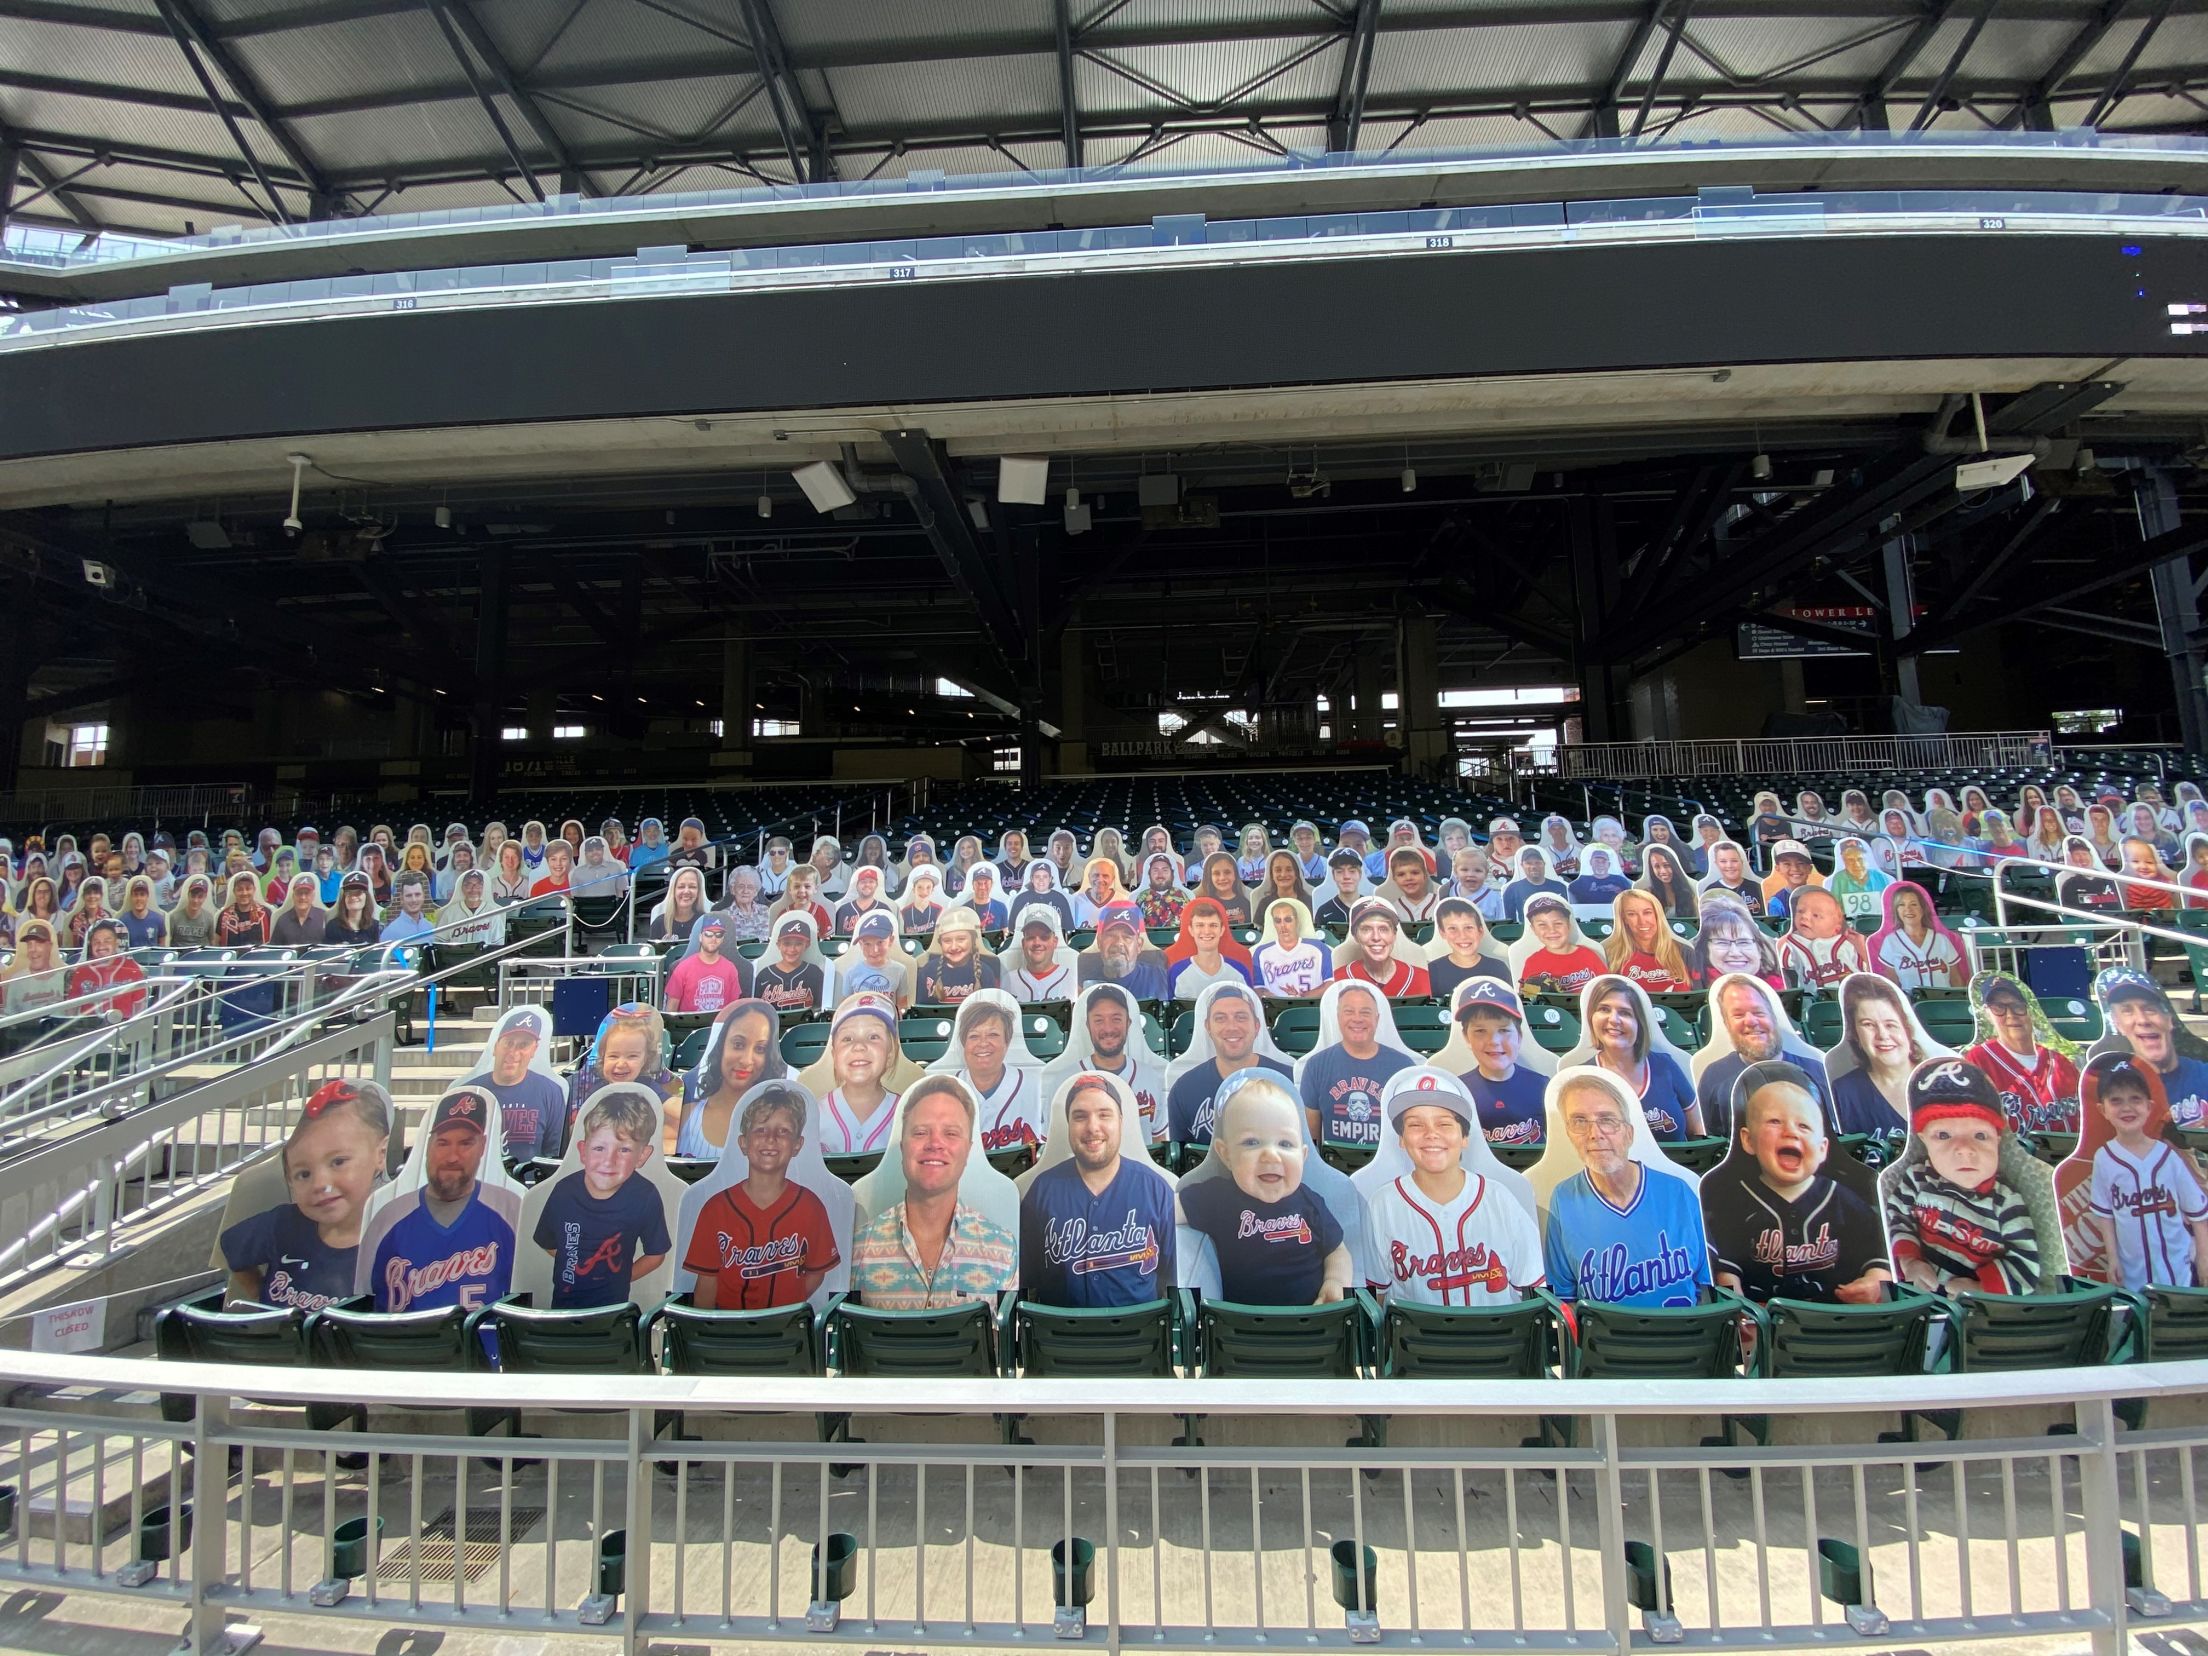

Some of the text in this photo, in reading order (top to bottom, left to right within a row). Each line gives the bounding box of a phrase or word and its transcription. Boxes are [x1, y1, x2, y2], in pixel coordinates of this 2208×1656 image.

[1983, 219, 2003, 229] 320
[1430, 237, 1450, 248] 318
[893, 268, 911, 278] 317
[396, 299, 414, 309] 316
[1849, 894, 1872, 914] 98
[1263, 956, 1316, 984] Braves
[1898, 955, 1940, 971] Braves
[1298, 974, 1311, 993] 5
[503, 1109, 539, 1133] VES
[981, 1116, 1023, 1149] ves
[1331, 1119, 1381, 1141] EMPIR
[1483, 1117, 1533, 1142] raves
[2110, 1183, 2166, 1211] Braves
[1044, 1208, 1148, 1268] Atlanta
[1237, 1209, 1301, 1240] Braves
[561, 1222, 581, 1285] BRAVES
[716, 1231, 799, 1268] Braves
[1755, 1222, 1838, 1263] tlanta
[1390, 1240, 1486, 1281] Braves
[1578, 1229, 1692, 1303] Atlanta
[268, 1271, 342, 1309] Brav
[385, 1241, 500, 1314] Braves
[459, 1283, 487, 1312] 5
